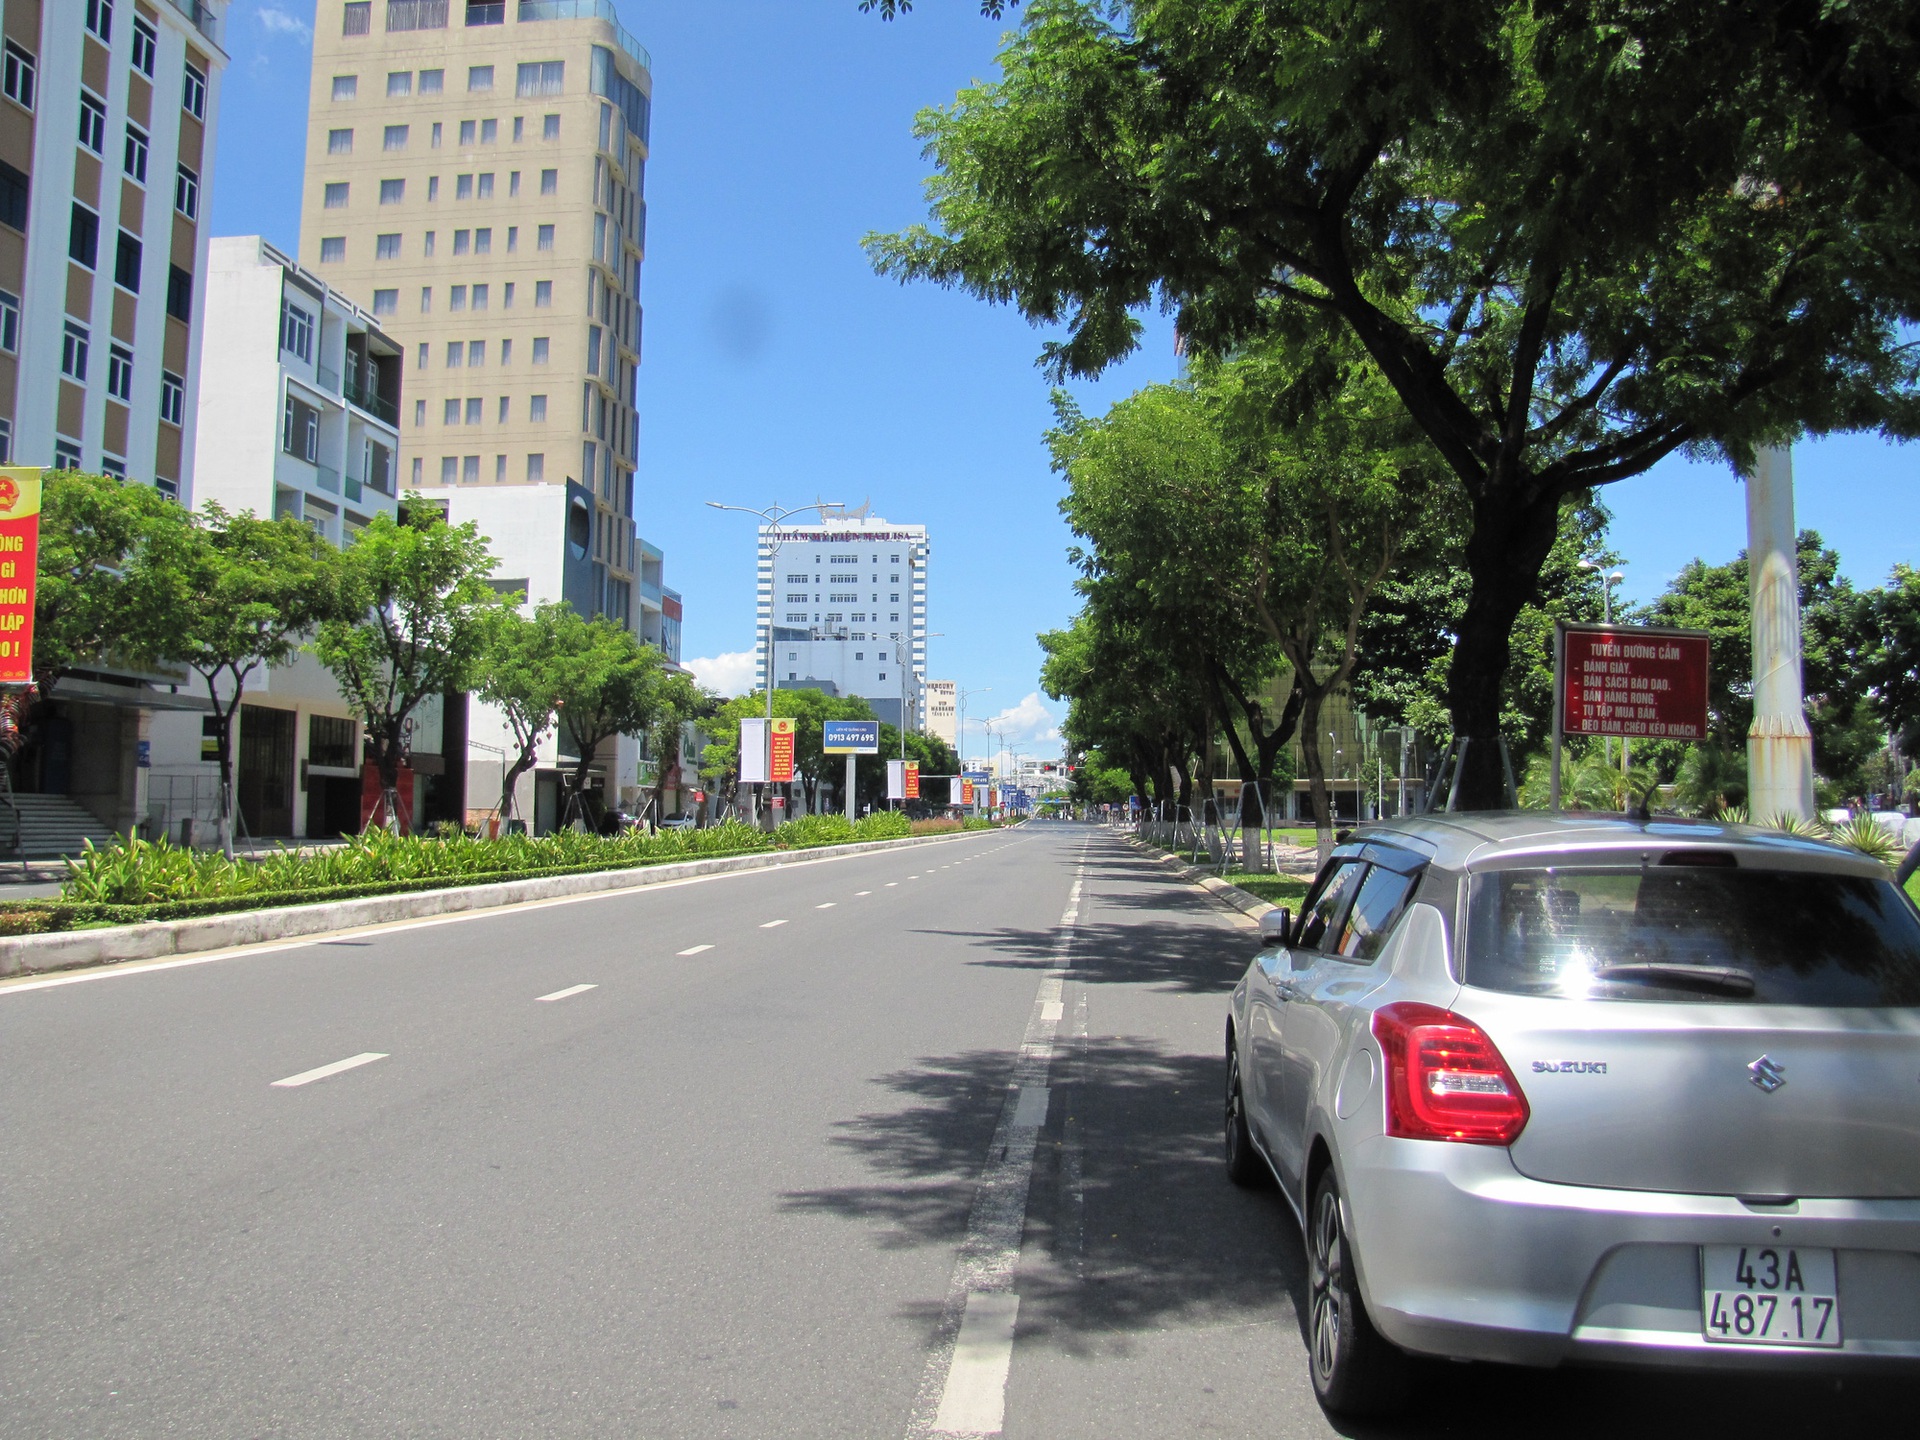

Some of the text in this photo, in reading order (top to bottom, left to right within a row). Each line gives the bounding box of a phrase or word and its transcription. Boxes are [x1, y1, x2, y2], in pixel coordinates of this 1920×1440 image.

[1, 560, 15, 578] GÌ
[0, 586, 27, 605] HƠN
[1, 613, 25, 634] LẬP
[1591, 639, 1620, 657] TUYẾN
[1624, 643, 1656, 659] ĐƯỜNG
[1605, 675, 1628, 689] SÁCH
[1615, 706, 1634, 718] MUA
[828, 733, 875, 741] 0913 497 695
[1532, 1060, 1607, 1074] SUZUKI
[1736, 1247, 1804, 1291] 43A
[1710, 1292, 1833, 1340] 487.17
